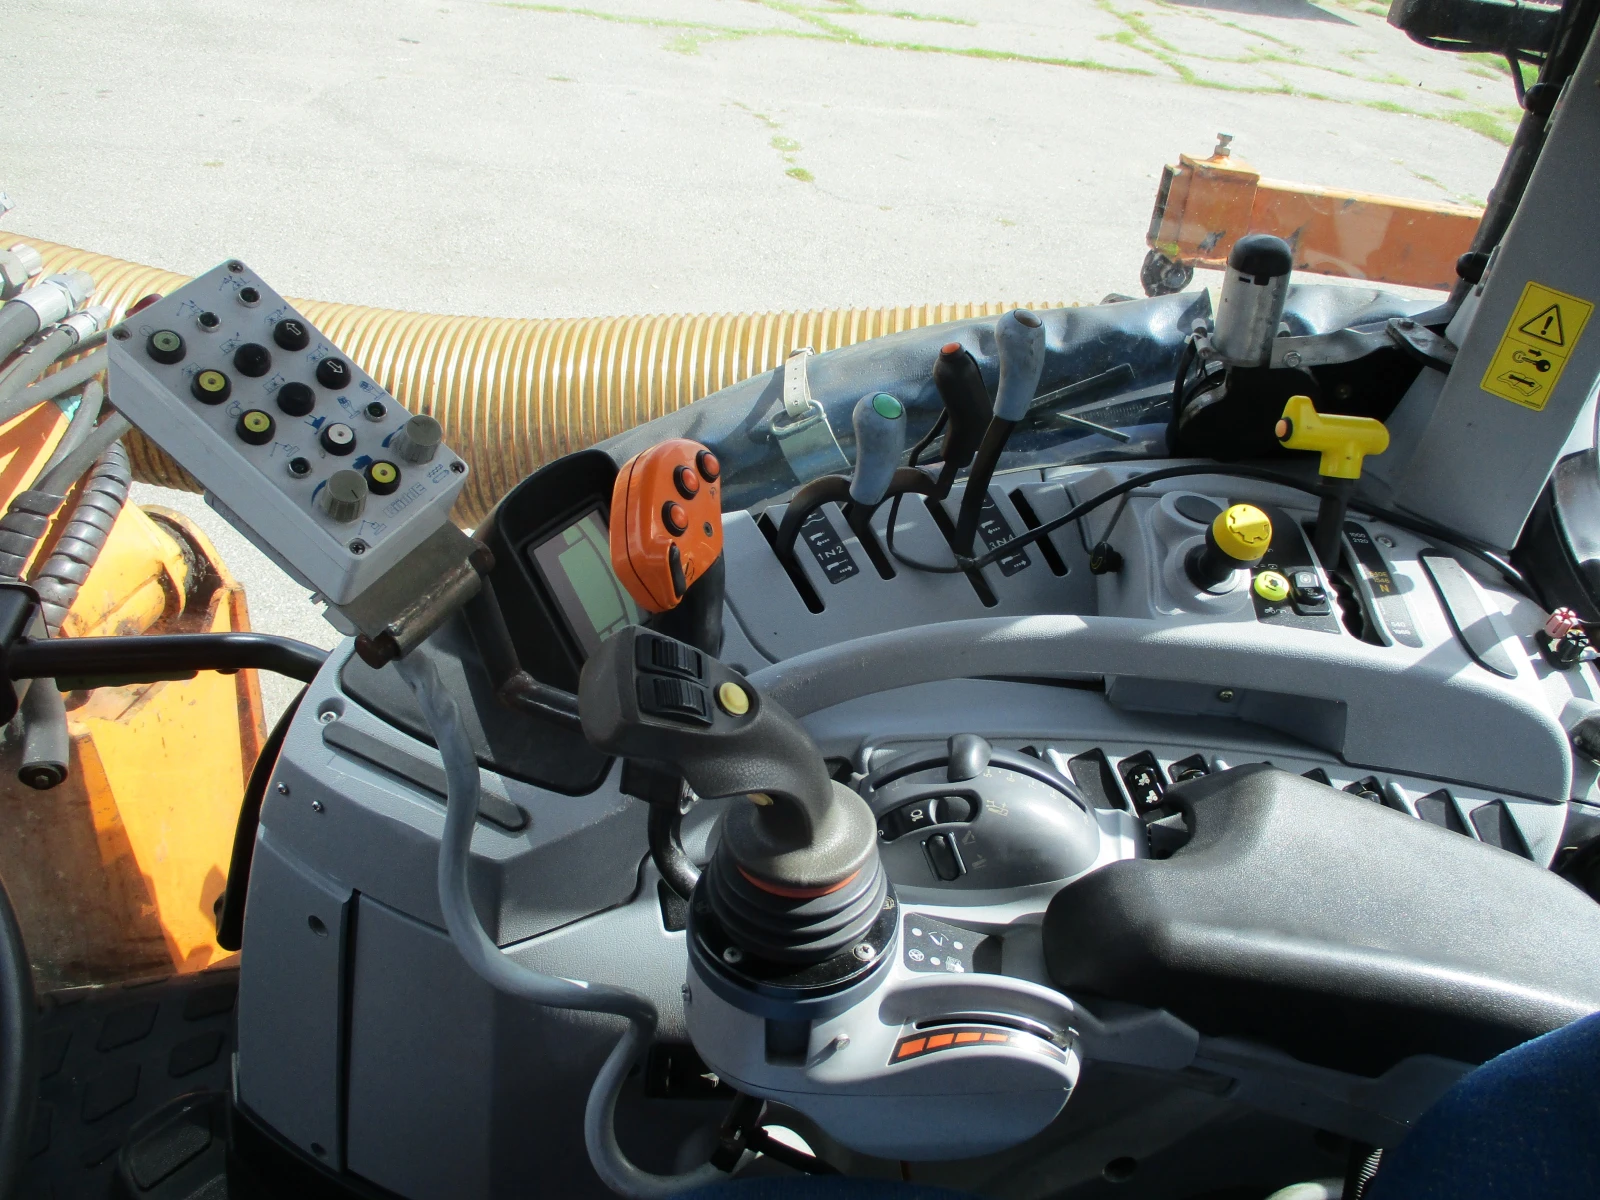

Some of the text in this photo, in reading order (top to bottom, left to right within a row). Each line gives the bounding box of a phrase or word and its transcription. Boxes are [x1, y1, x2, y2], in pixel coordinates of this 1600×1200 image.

[824, 549, 837, 558] N
[1380, 584, 1390, 592] N
[910, 809, 924, 822] 10
